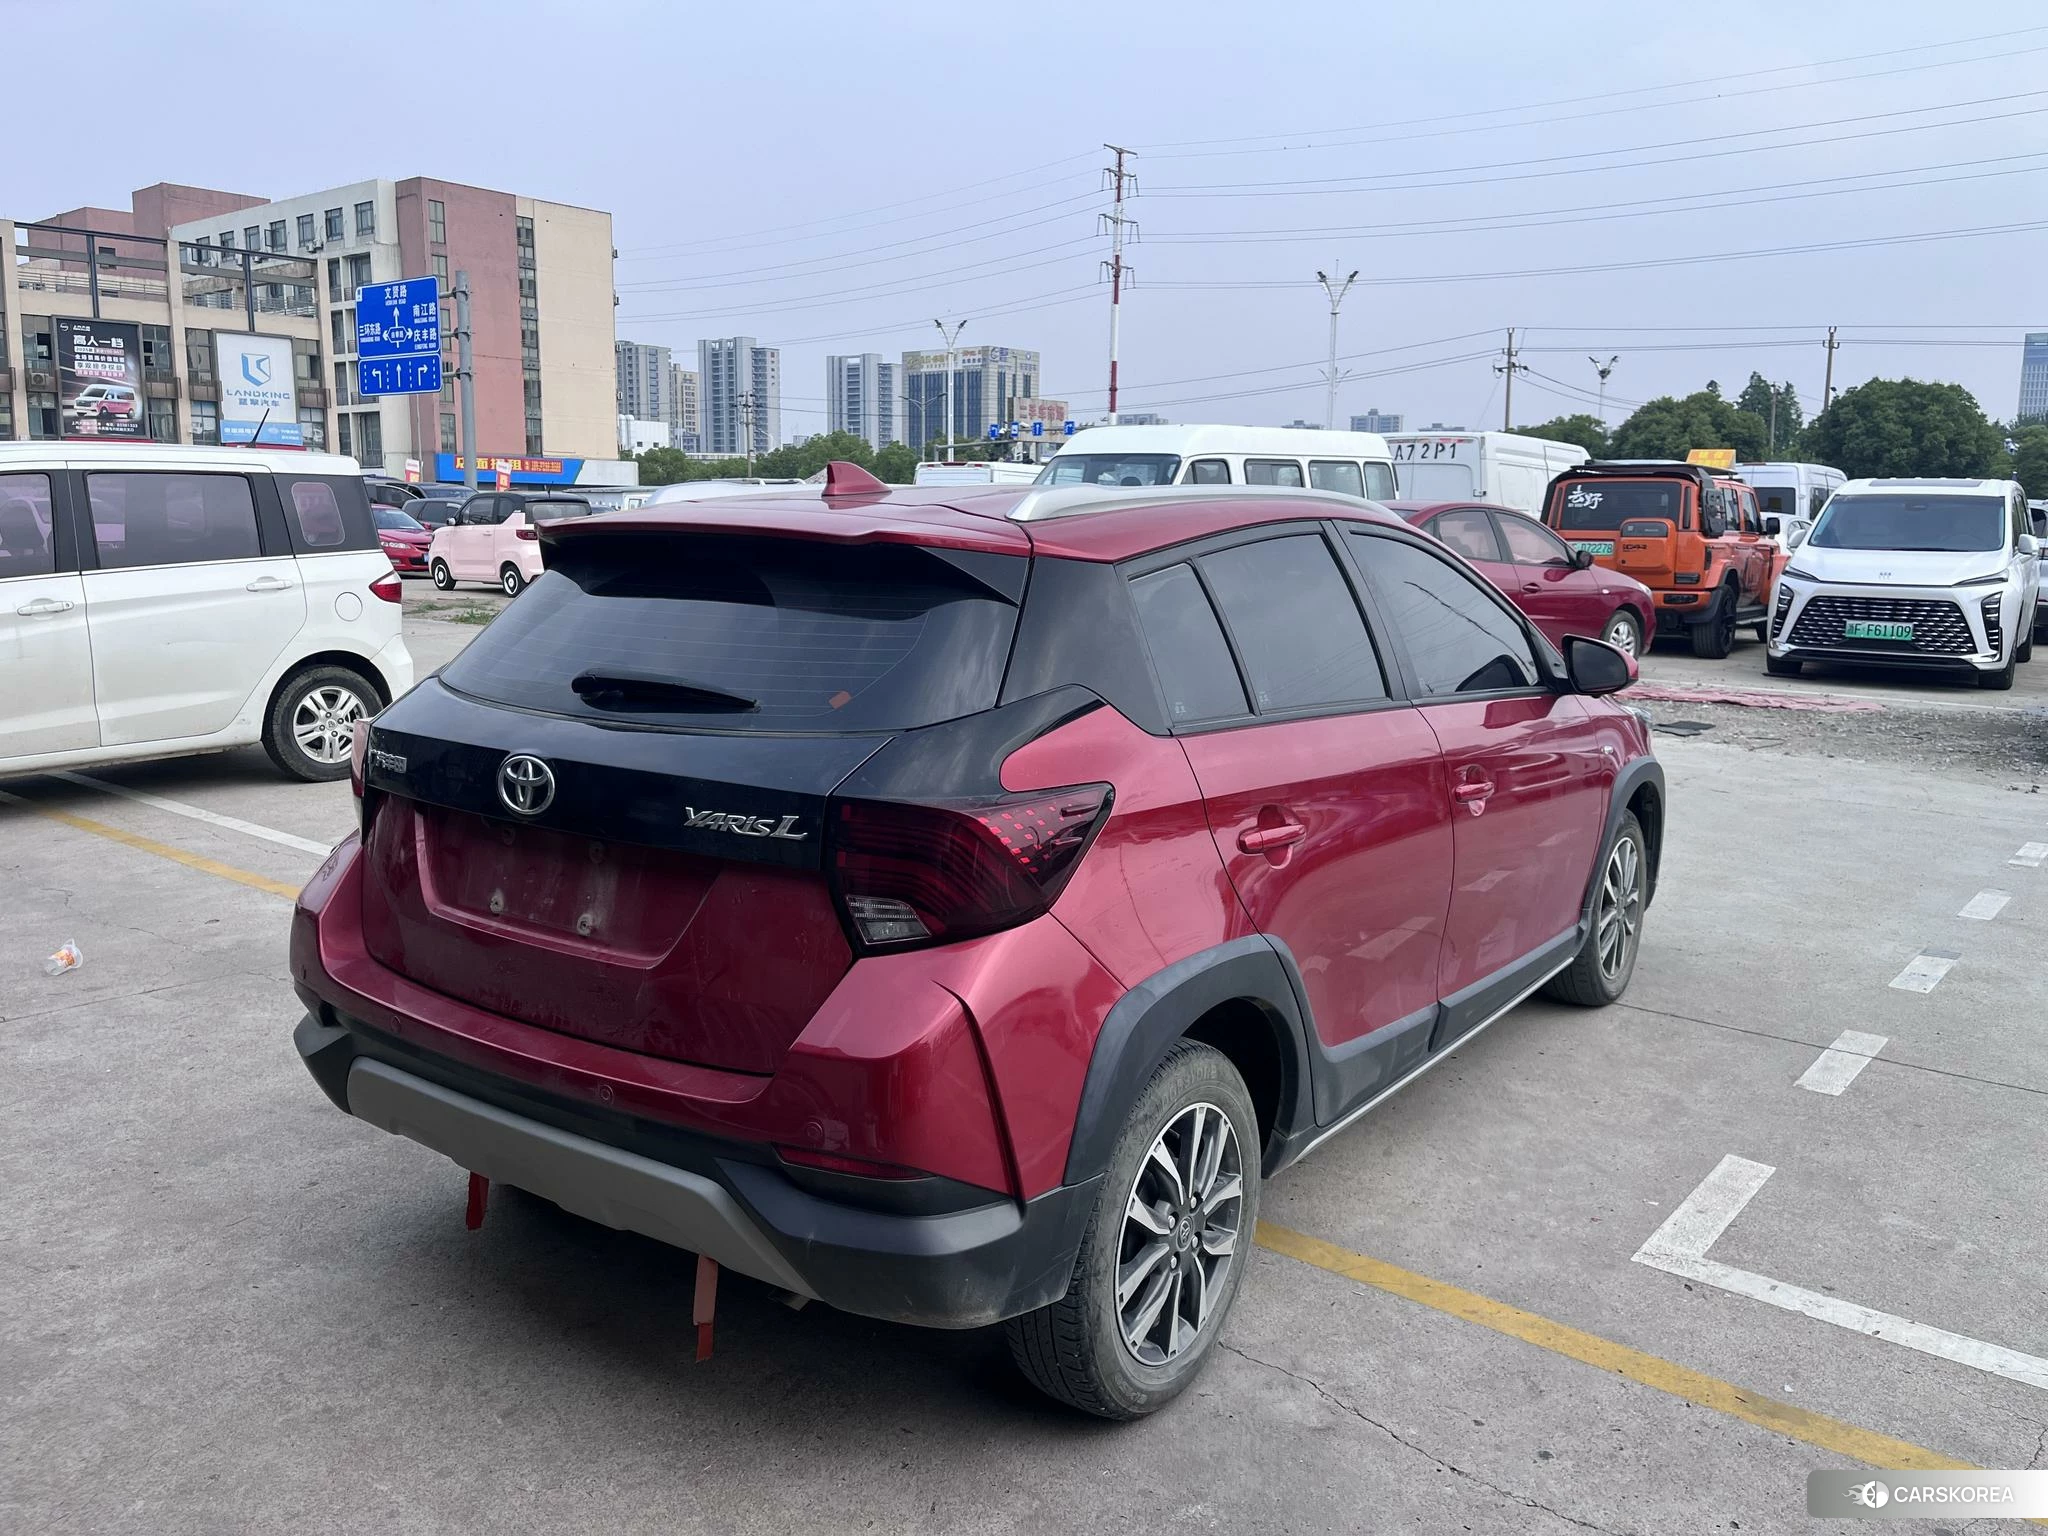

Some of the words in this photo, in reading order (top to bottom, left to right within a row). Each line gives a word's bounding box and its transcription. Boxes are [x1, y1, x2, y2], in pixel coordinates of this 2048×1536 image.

[384, 285, 407, 299] 文贤路
[414, 328, 437, 342] 庆丰路
[226, 389, 291, 400] LANDKING
